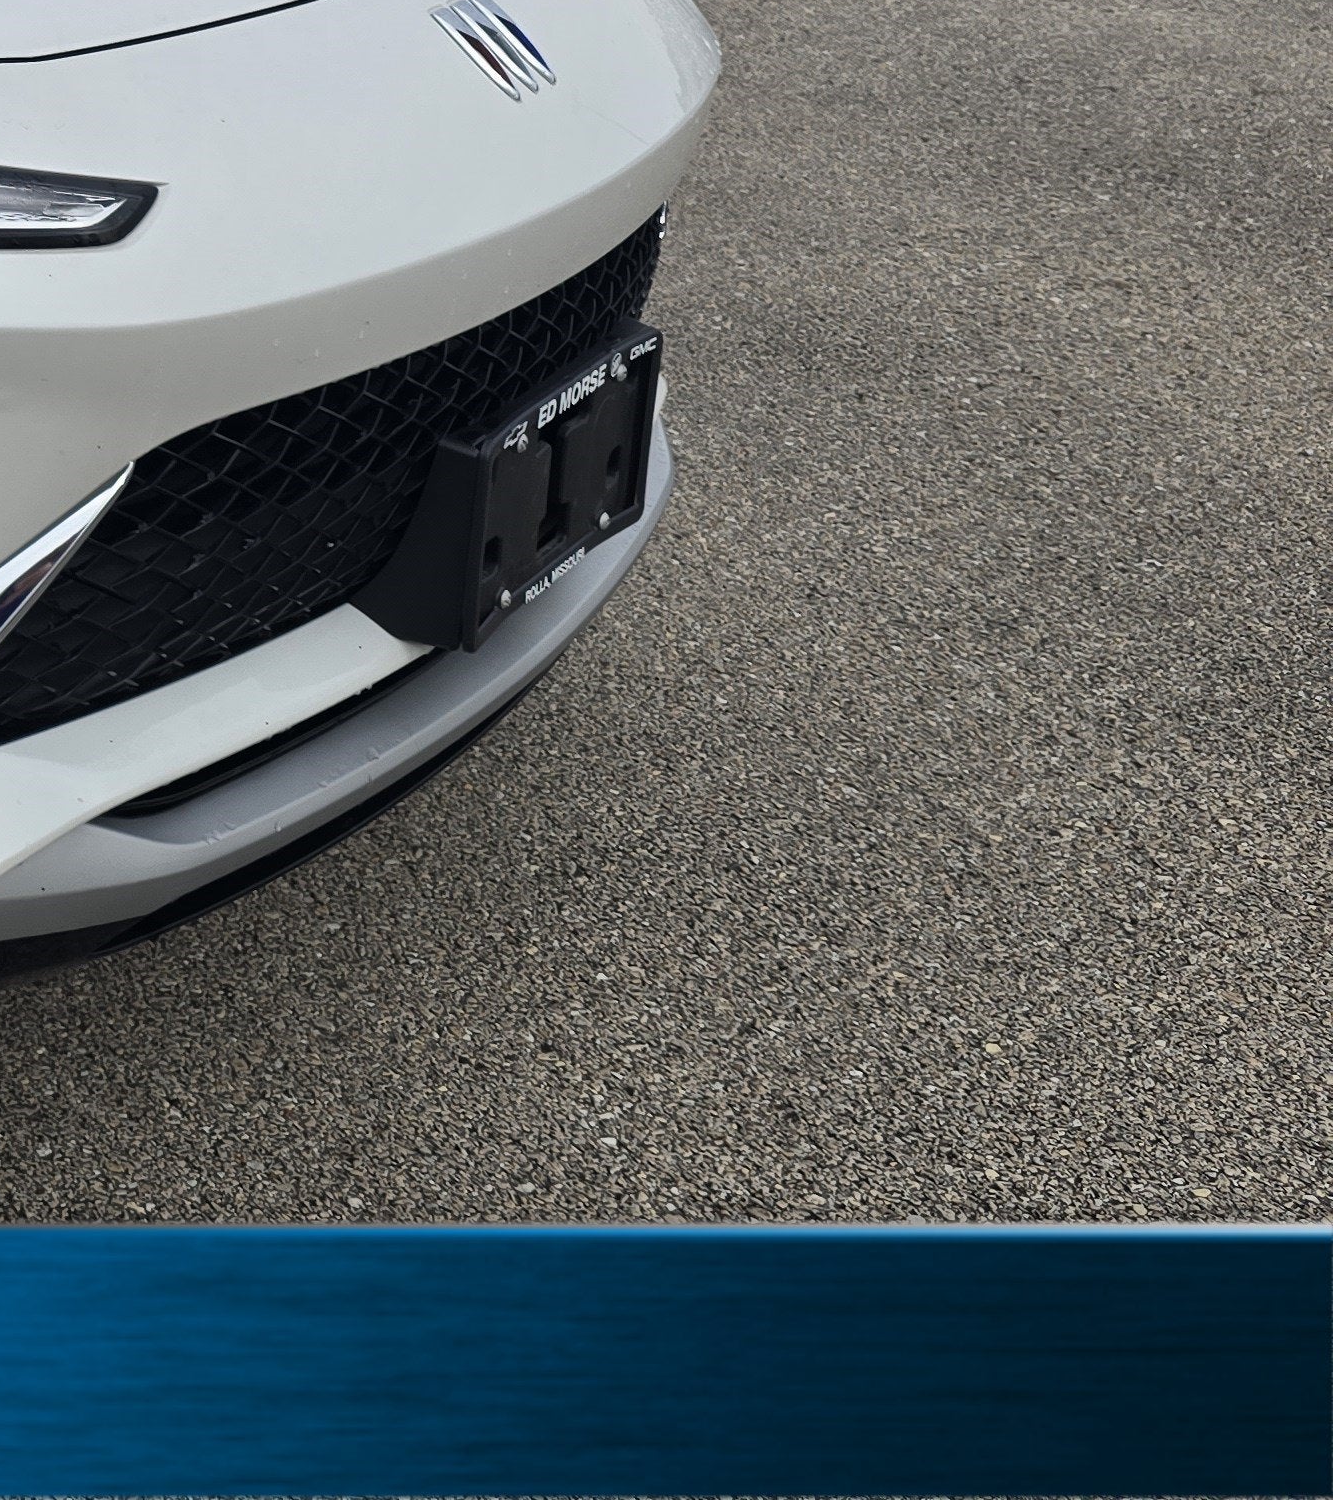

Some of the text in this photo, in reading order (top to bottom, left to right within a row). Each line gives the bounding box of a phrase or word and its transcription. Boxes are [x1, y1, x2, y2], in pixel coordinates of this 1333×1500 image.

[629, 336, 658, 361] GMC
[537, 363, 608, 430] ED MORSE
